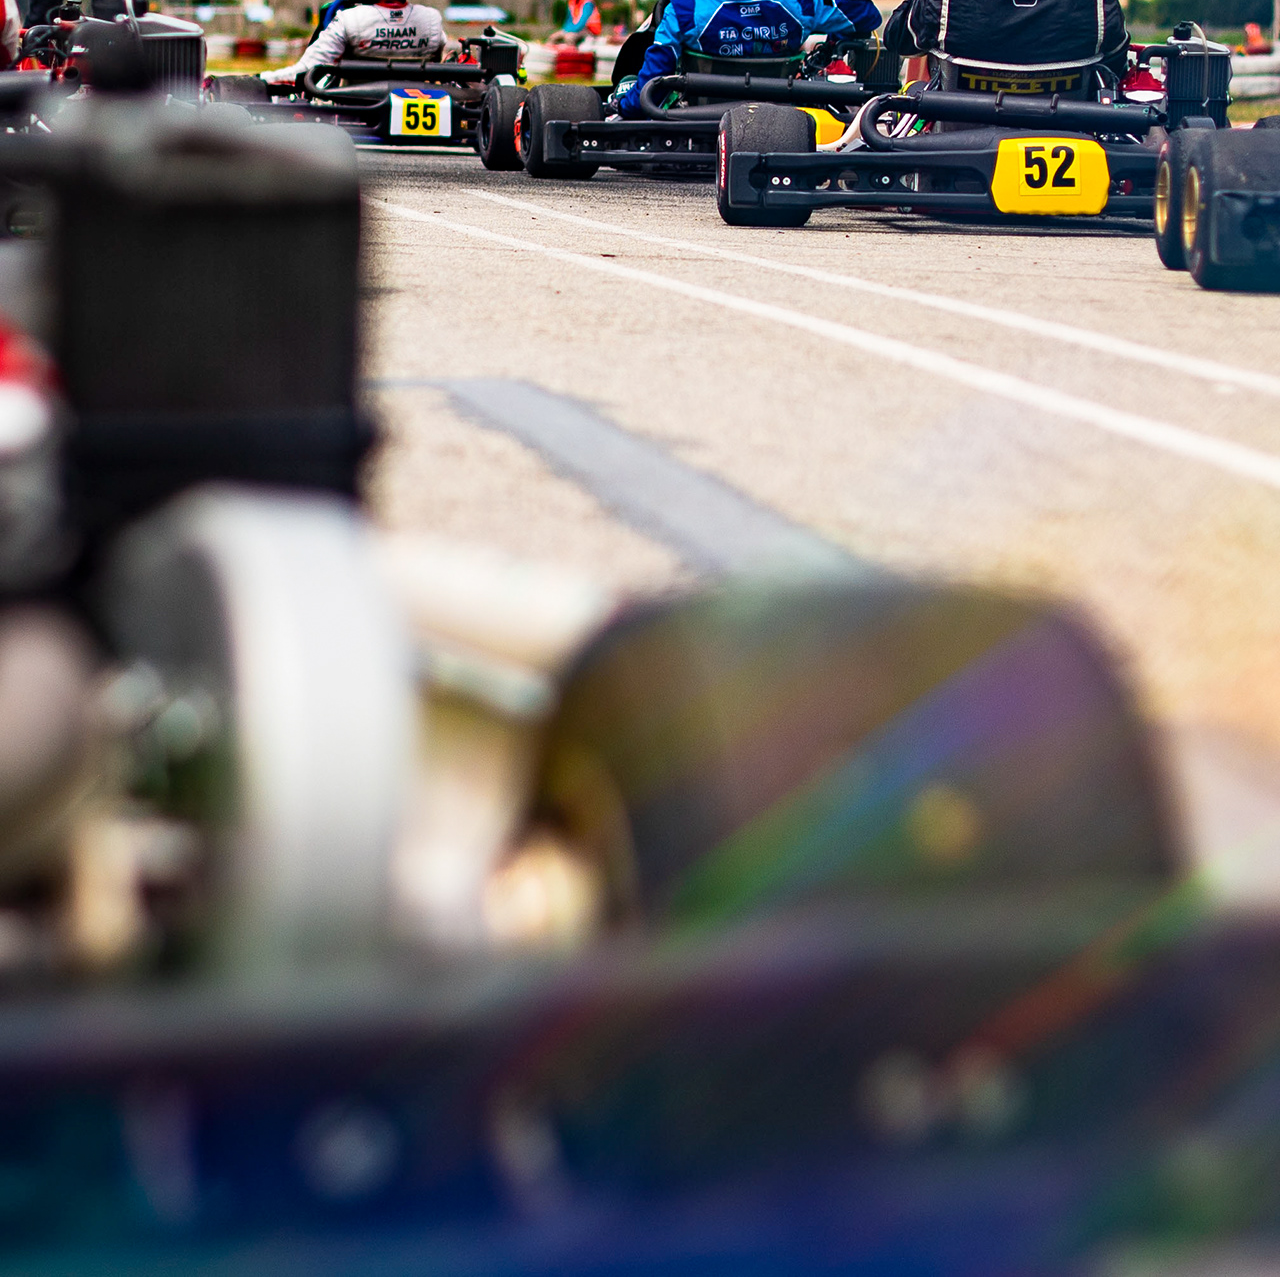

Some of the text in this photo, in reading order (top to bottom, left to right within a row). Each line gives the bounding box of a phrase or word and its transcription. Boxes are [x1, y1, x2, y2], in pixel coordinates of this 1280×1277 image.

[740, 6, 761, 15] OMP
[376, 27, 416, 37] ISHAAN
[720, 23, 789, 41] FIA GIRLS
[370, 38, 429, 49] PAROLIN
[719, 43, 744, 57] ON
[405, 103, 436, 131] 55
[1024, 146, 1076, 189] 52
